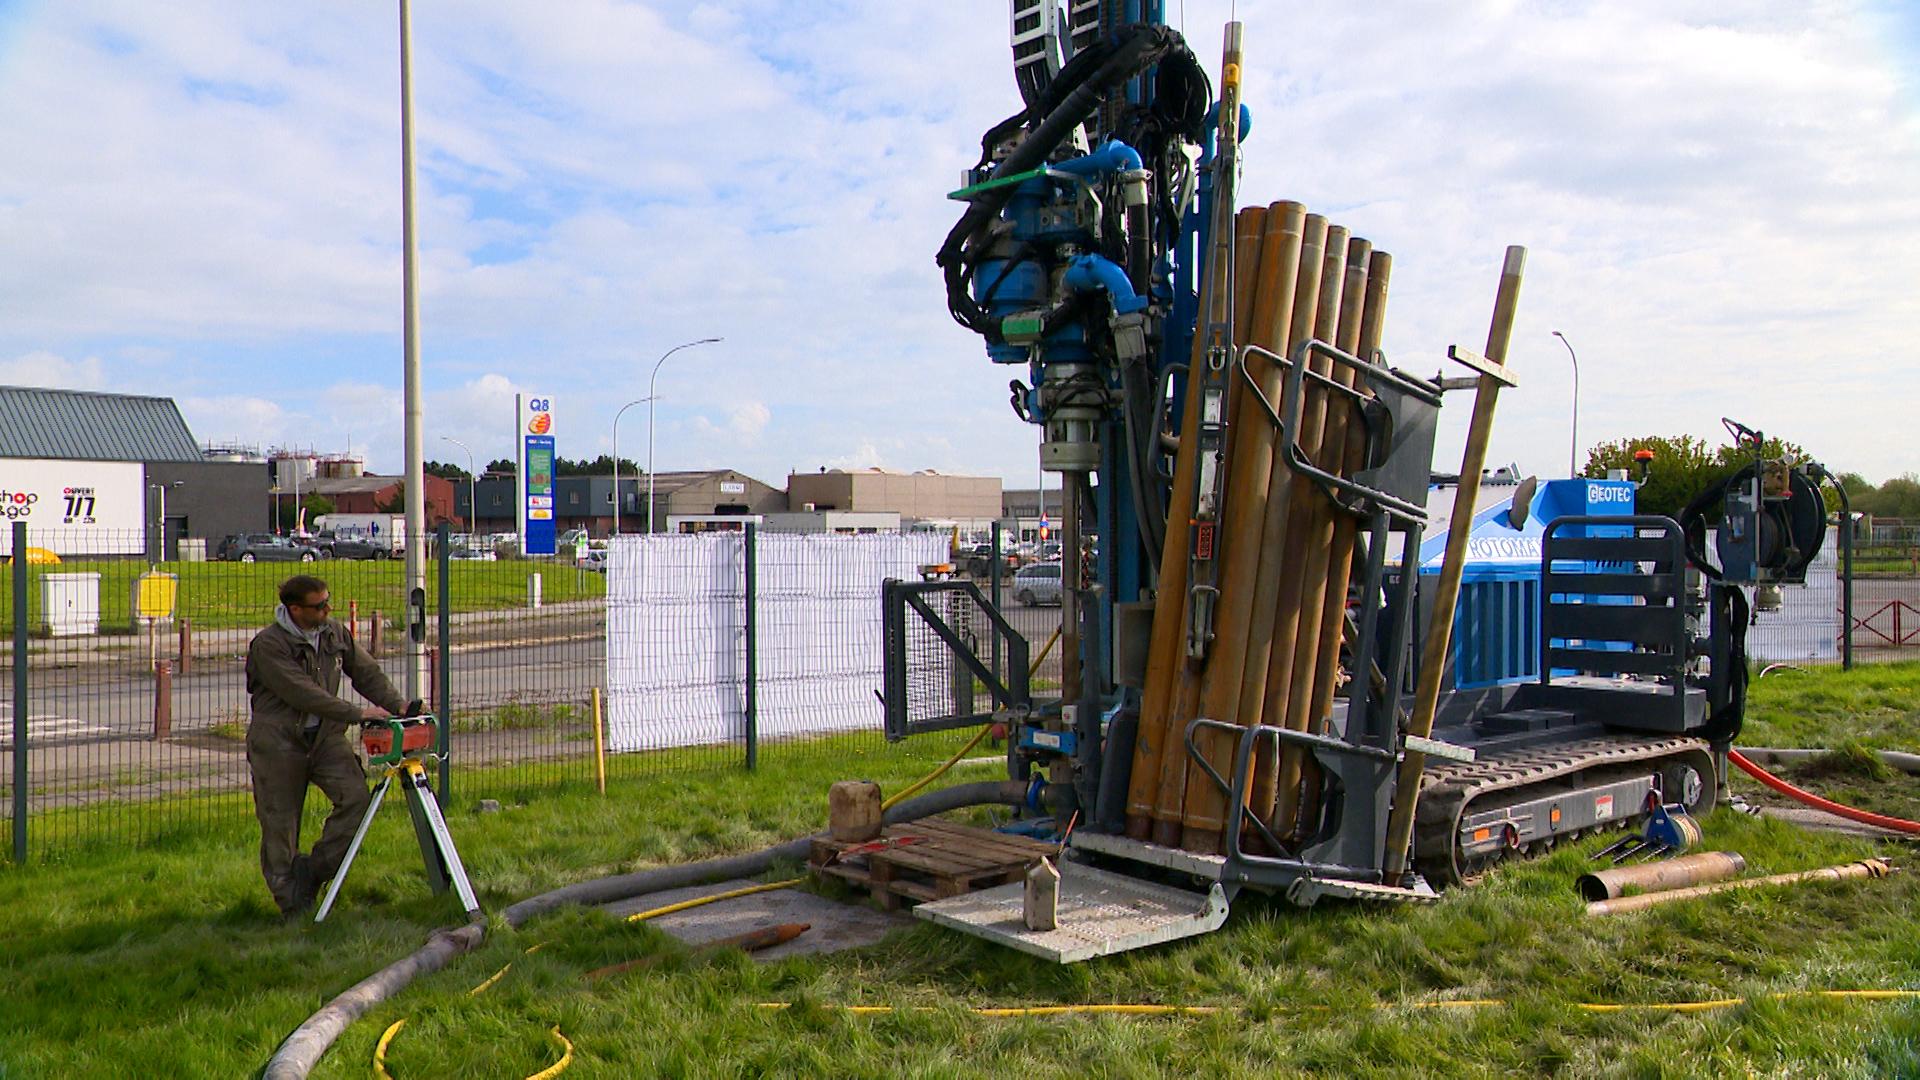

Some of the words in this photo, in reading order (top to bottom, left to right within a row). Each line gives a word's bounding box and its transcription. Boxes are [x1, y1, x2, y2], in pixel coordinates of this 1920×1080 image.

[530, 399, 549, 412] Q8
[0, 490, 38, 505] hop
[1588, 484, 1630, 503] GEOTEC
[64, 497, 95, 516] 7/7
[1469, 537, 1541, 557] ROTOMA
